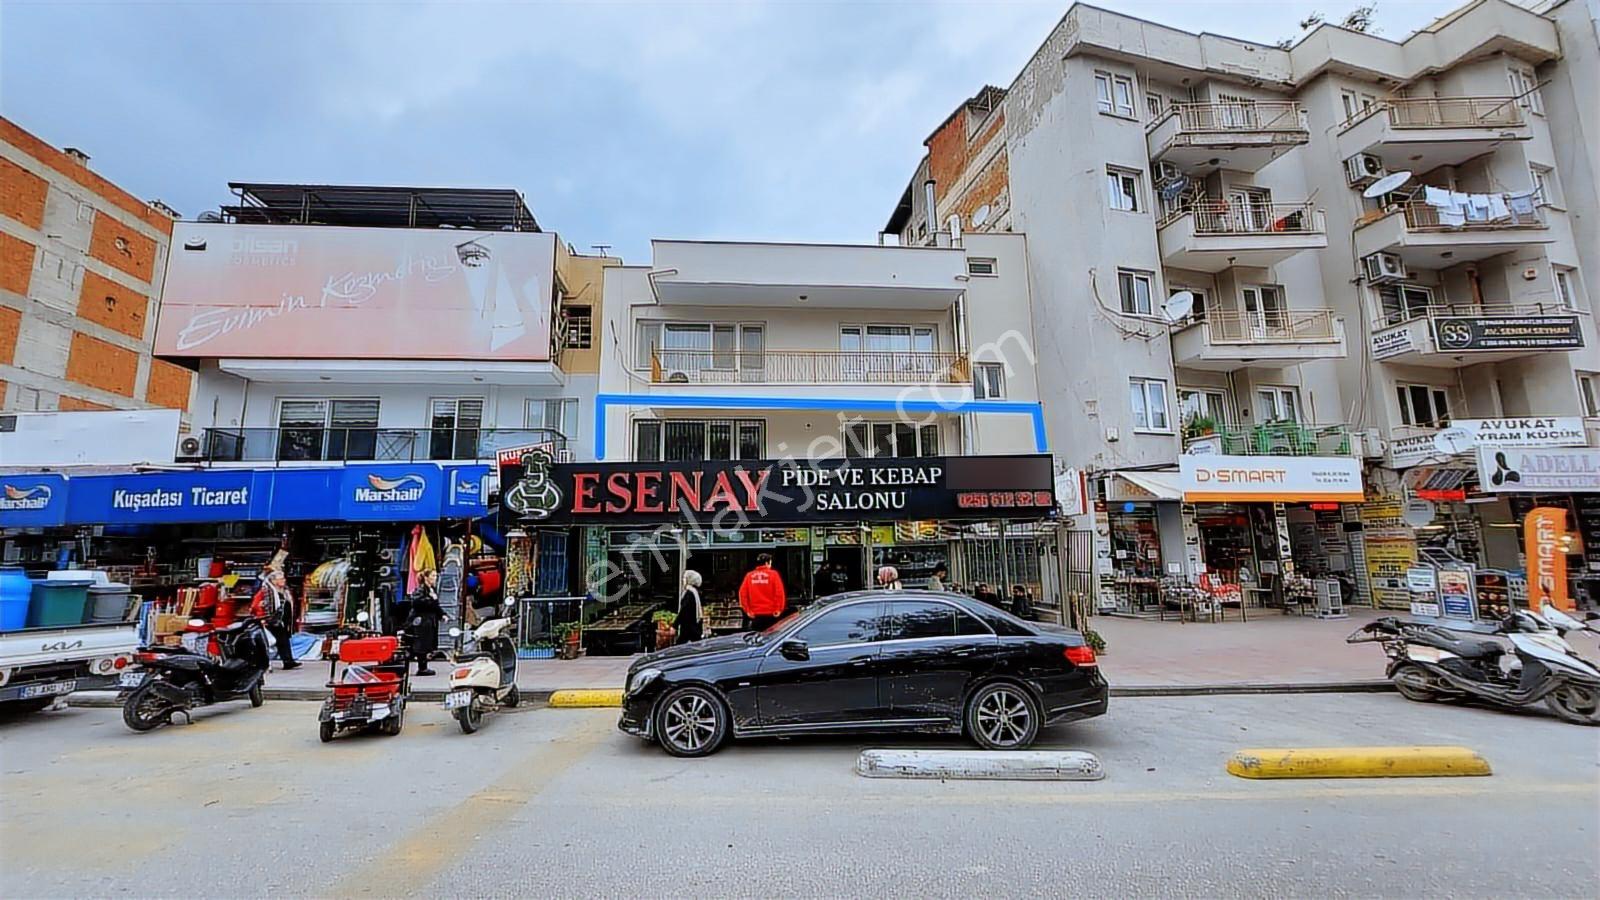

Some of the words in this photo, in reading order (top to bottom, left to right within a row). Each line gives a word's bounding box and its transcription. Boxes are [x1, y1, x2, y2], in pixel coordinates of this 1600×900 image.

[176, 292, 308, 351] Evimin
[1373, 329, 1407, 344] AVUKAT
[1443, 325, 1469, 342] SS
[1480, 419, 1556, 430] AVUKAT
[356, 487, 422, 502] Marshall
[571, 470, 771, 513] ESENAY
[782, 465, 831, 486] PİDE
[835, 469, 865, 486] VE
[869, 467, 942, 485] KEBAP
[114, 489, 182, 511] Kuşadası
[192, 487, 248, 505] Ticaret
[816, 492, 906, 510] SALONU
